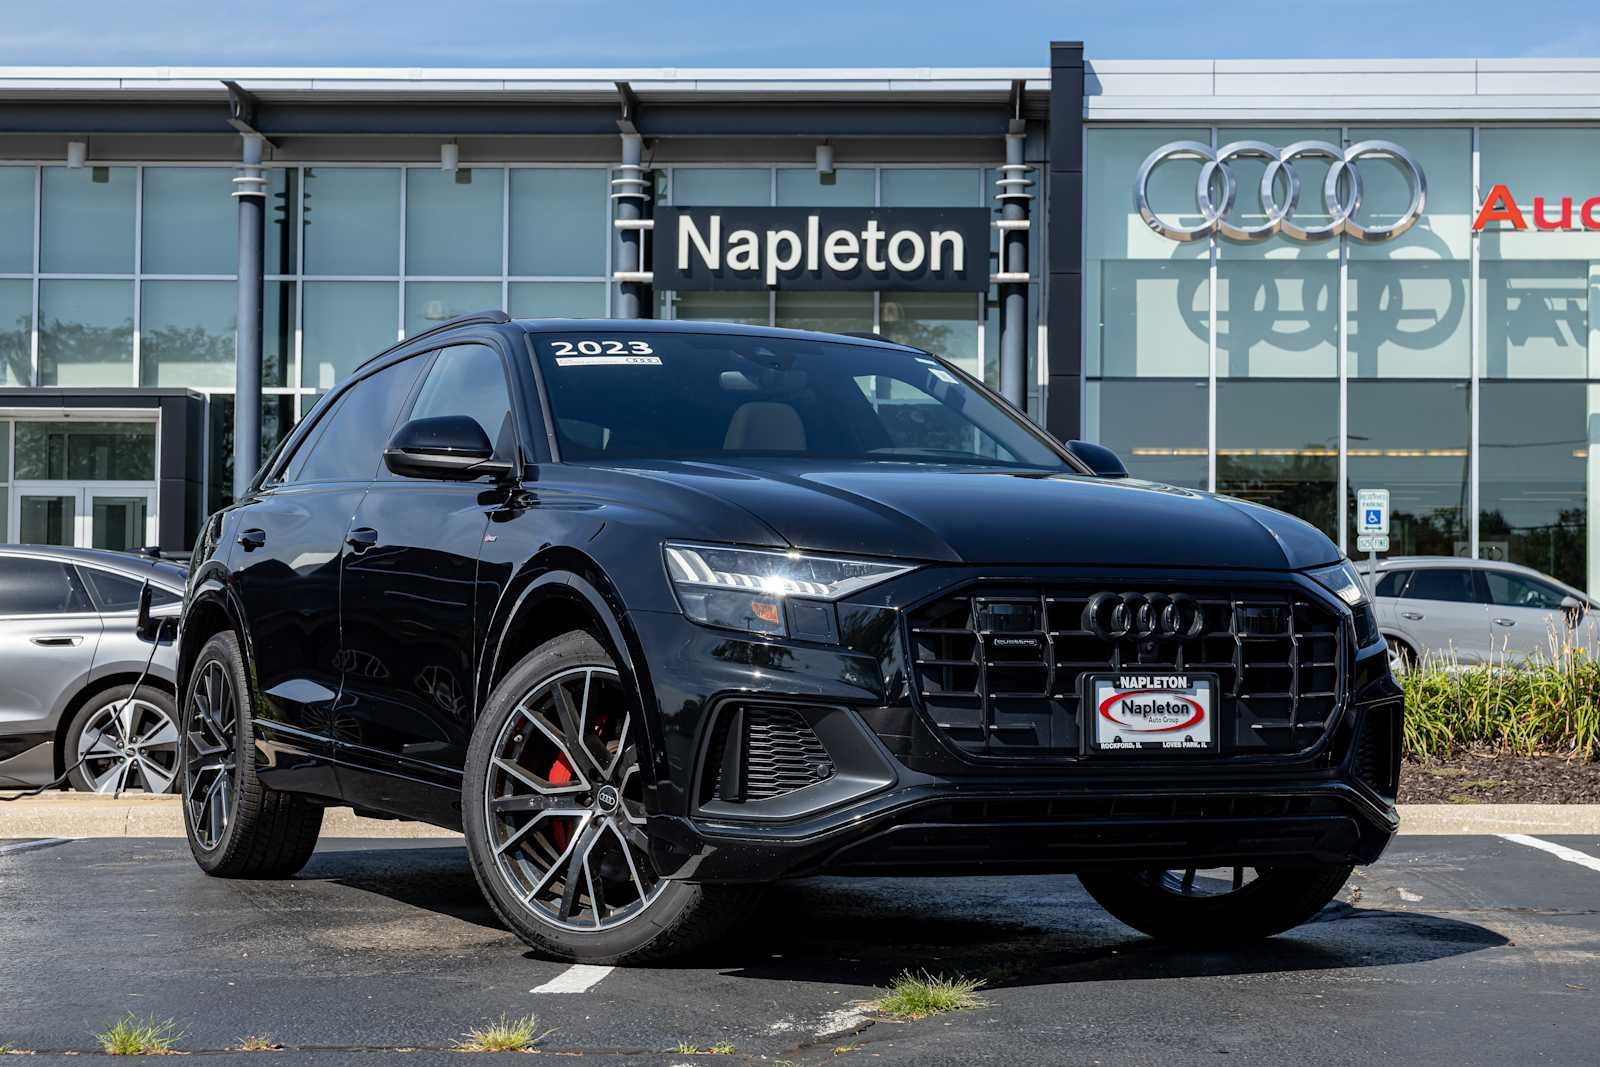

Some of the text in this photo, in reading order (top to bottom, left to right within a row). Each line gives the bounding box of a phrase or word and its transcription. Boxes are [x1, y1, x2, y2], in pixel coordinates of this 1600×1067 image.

[678, 215, 964, 285] Napleton
[551, 341, 653, 355] 2023
[1120, 676, 1187, 688] NAPLETON
[1121, 699, 1189, 718] Napleton
